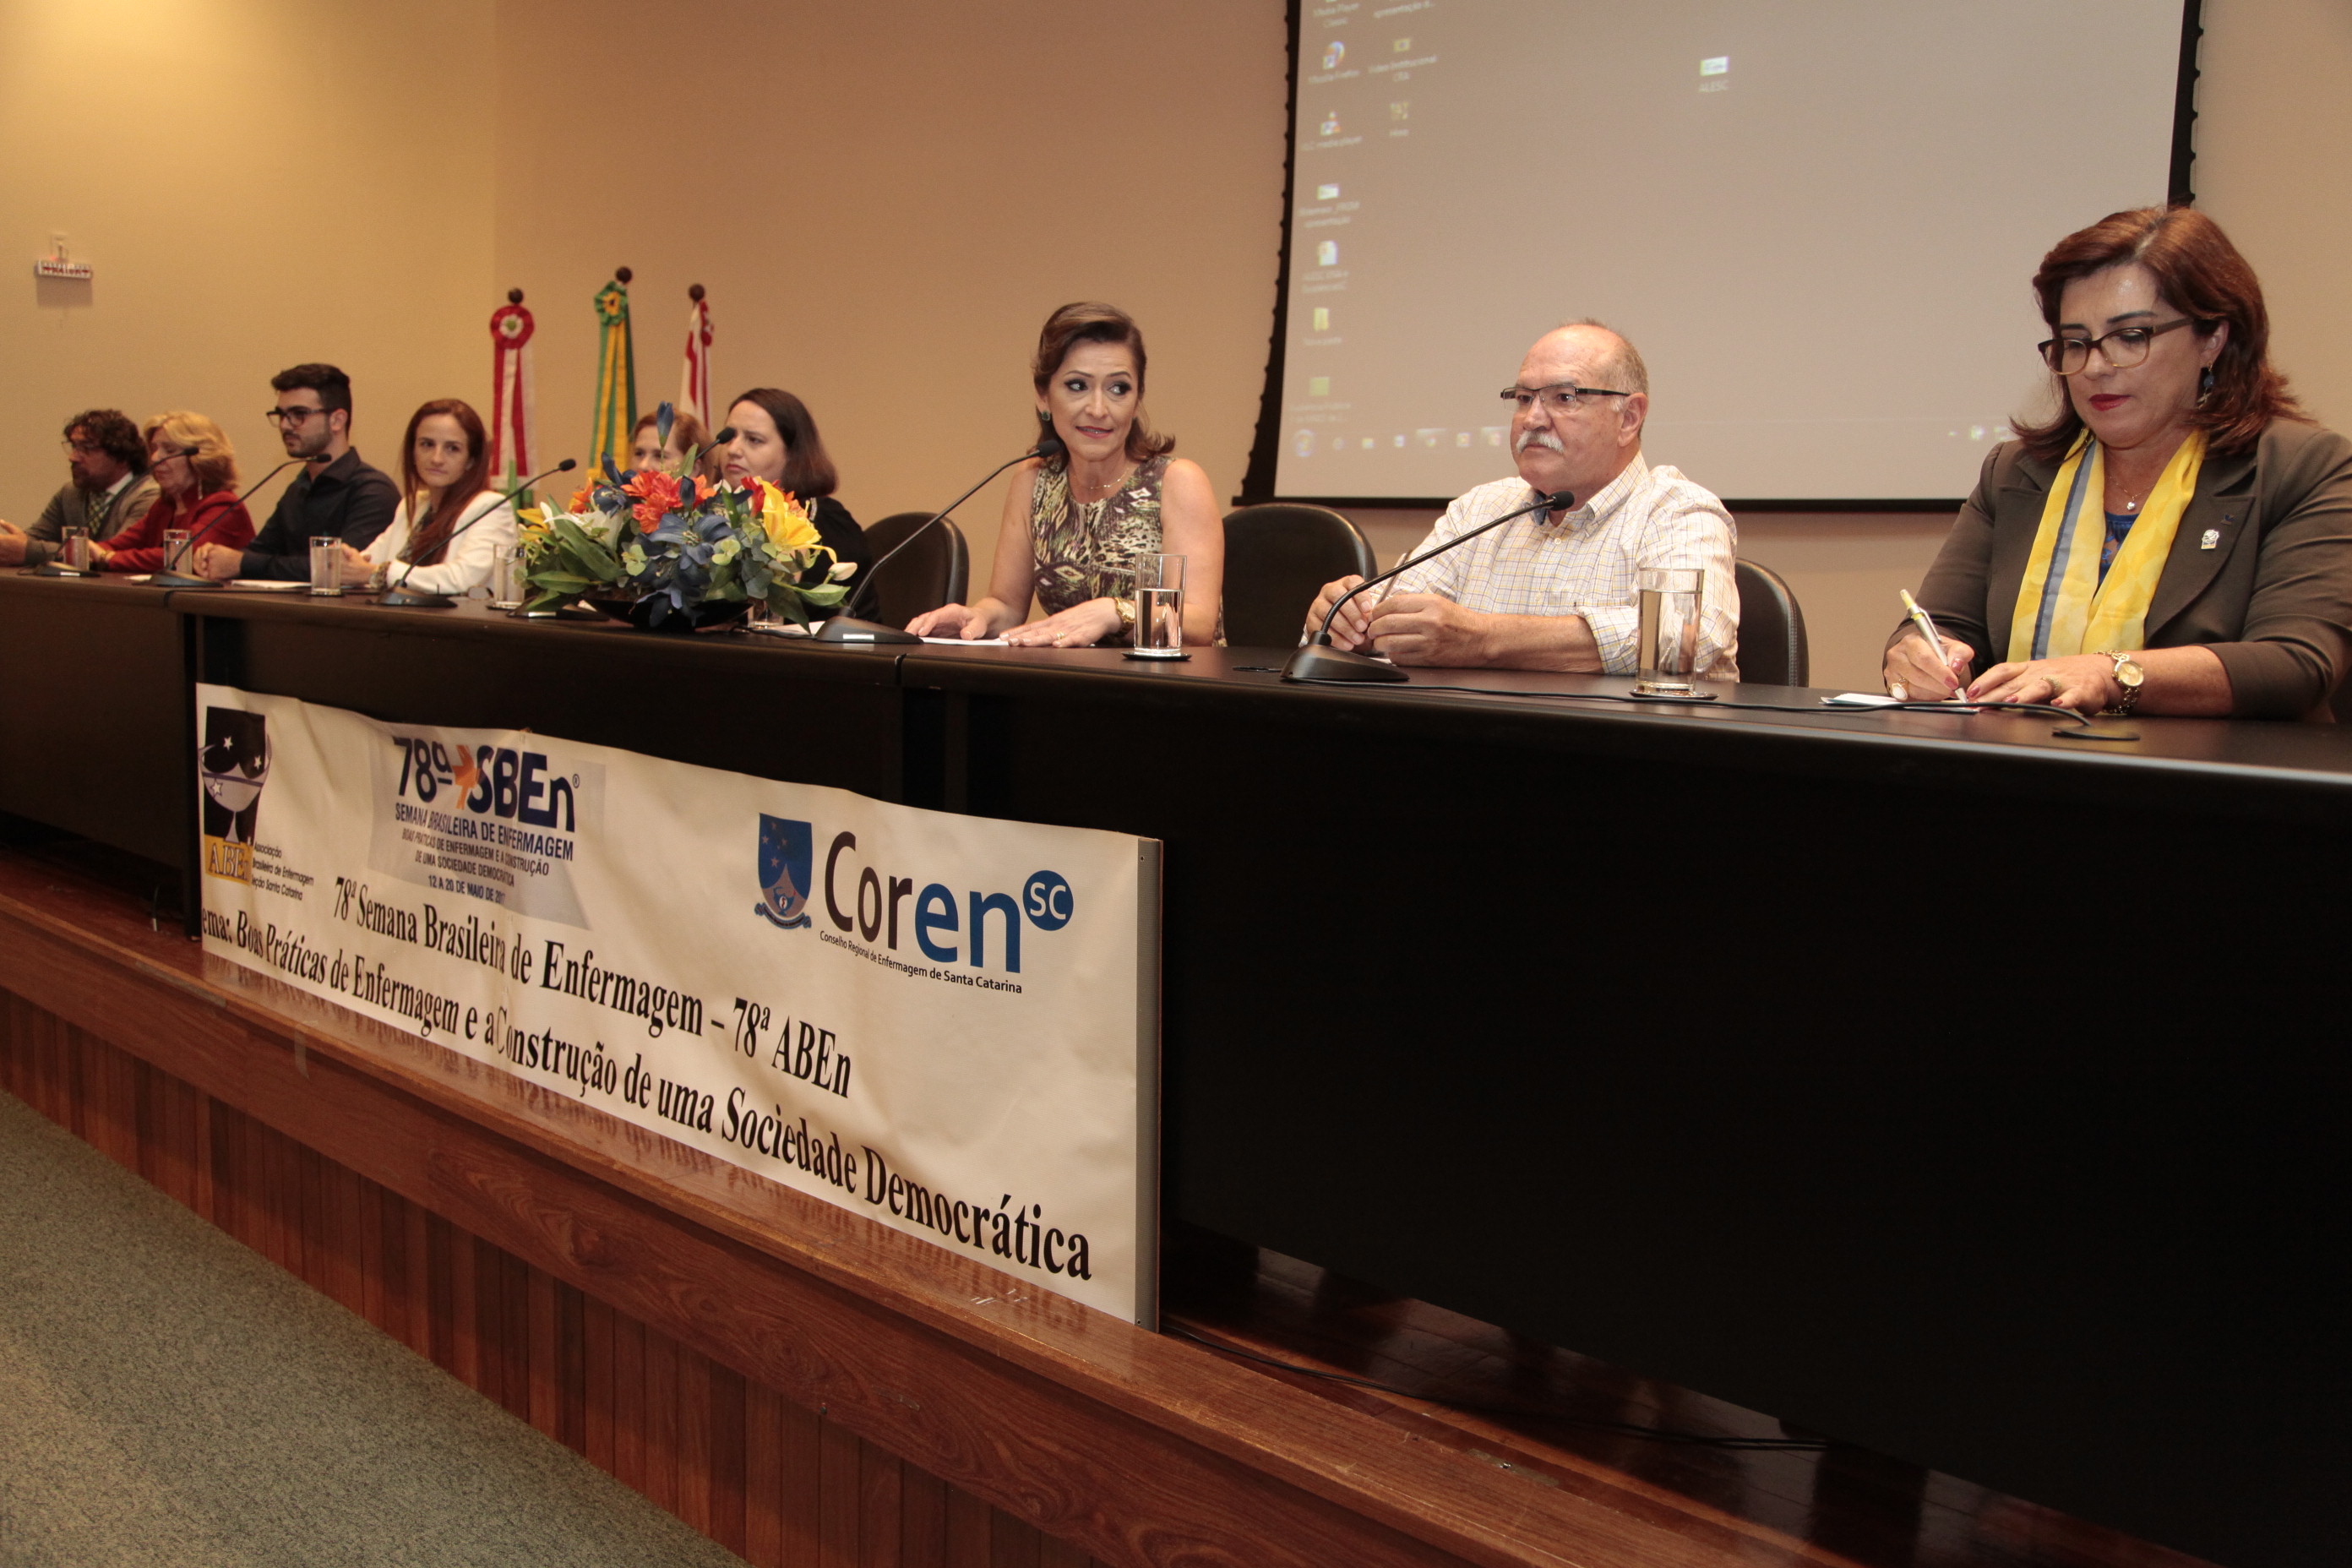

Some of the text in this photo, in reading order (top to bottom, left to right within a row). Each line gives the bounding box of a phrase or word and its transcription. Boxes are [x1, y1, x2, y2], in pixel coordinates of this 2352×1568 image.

[393, 736, 453, 803] 78ª
[395, 803, 574, 861] SEMANA BRASILEIRA DE ENFERMAGEM
[402, 828, 415, 842] BOAS
[437, 839, 444, 851] DE
[446, 840, 494, 861] ENFERMAGEM
[495, 851, 500, 862] E
[500, 852, 505, 863] A
[252, 874, 302, 901] eção Santa Catarina
[275, 864, 281, 877] de
[282, 867, 314, 888] Enfermagem
[415, 850, 422, 863] DE
[423, 852, 436, 867] UMA
[438, 857, 476, 875] SOCIEDADE
[428, 874, 437, 888] 12
[438, 877, 444, 890] A
[445, 879, 454, 892] 20
[456, 880, 465, 894] DE
[467, 882, 484, 899] MAIO
[486, 887, 494, 901] DE
[825, 830, 1067, 973] Coren SC
[334, 876, 357, 921] 78ª
[357, 884, 418, 944] Semana
[423, 903, 507, 975] Brasileira
[511, 933, 532, 984] de
[539, 939, 703, 1038] Enfermagem
[732, 997, 771, 1058] 78ª
[771, 1015, 852, 1098] ABEn
[819, 930, 1022, 994] Conselho Regional de Enfermagem de Santa Catarina
[202, 907, 1092, 1281] ema: Boas Práticas de Enfermagem e a Construção de uma Sociedade Democrática
